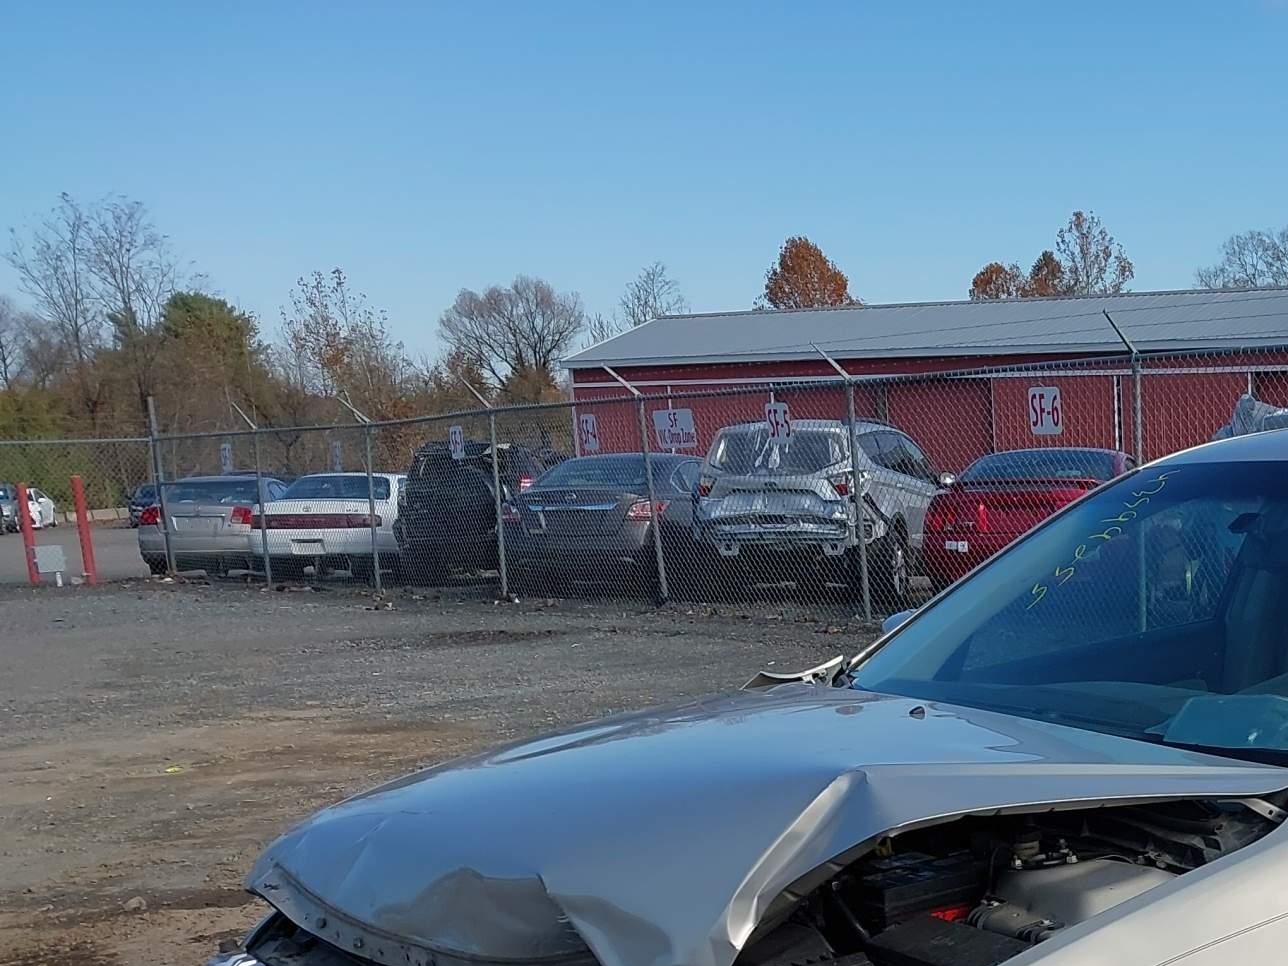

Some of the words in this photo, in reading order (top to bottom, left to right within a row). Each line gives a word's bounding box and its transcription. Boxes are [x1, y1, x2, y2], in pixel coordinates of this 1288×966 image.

[668, 412, 678, 428] SF
[767, 409, 791, 438] SF-5
[1031, 393, 1059, 427] SF-6
[581, 419, 598, 445] SF-4
